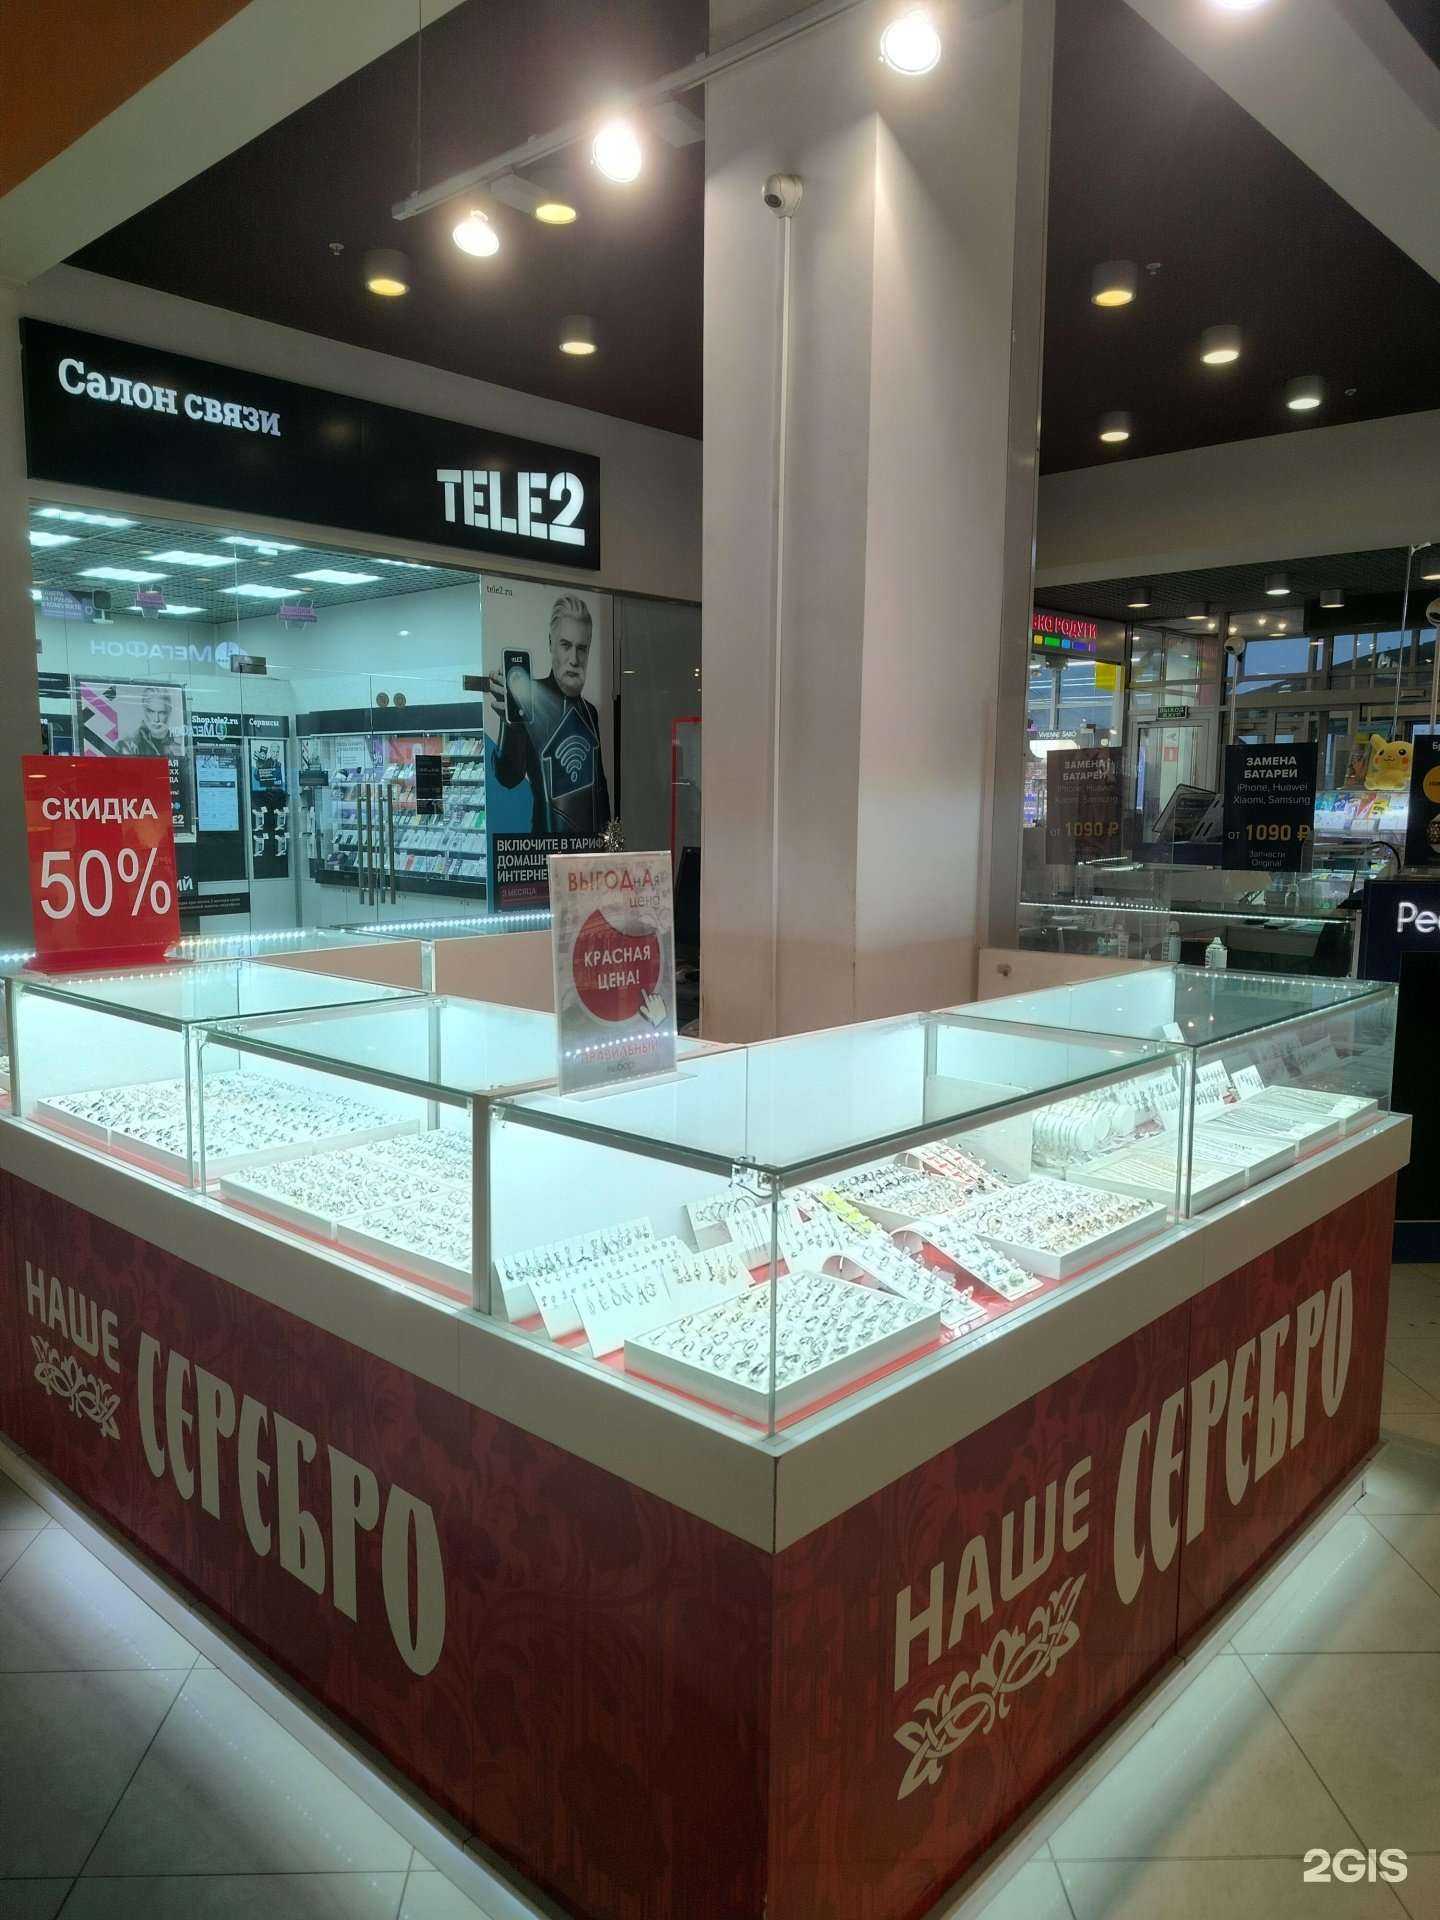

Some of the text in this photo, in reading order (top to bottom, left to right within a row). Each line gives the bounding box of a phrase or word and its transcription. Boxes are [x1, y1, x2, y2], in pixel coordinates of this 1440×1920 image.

[58, 357, 281, 437] Салон связи
[436, 468, 585, 546] TELE2
[1246, 756, 1297, 767] ЗАМЕНА
[1244, 769, 1298, 779] БАТАРЕИ
[42, 797, 158, 824] СКИДКА
[1247, 824, 1292, 841] 1090
[497, 839, 559, 852] ВКЛЮЧИТЕ
[560, 839, 569, 850] В
[497, 854, 550, 869] ДОМАШН
[40, 847, 171, 919] 50%
[497, 869, 549, 883] ИНТЕРНЕ
[1397, 901, 1440, 933] Pe
[584, 945, 651, 967] КРАСНАЯ
[598, 969, 640, 991] ЦЕНА!
[26, 1260, 446, 1677] НАШЕ СЕРЕБРО
[894, 1270, 1353, 1692] НАШЕ СЕРЕБРО
